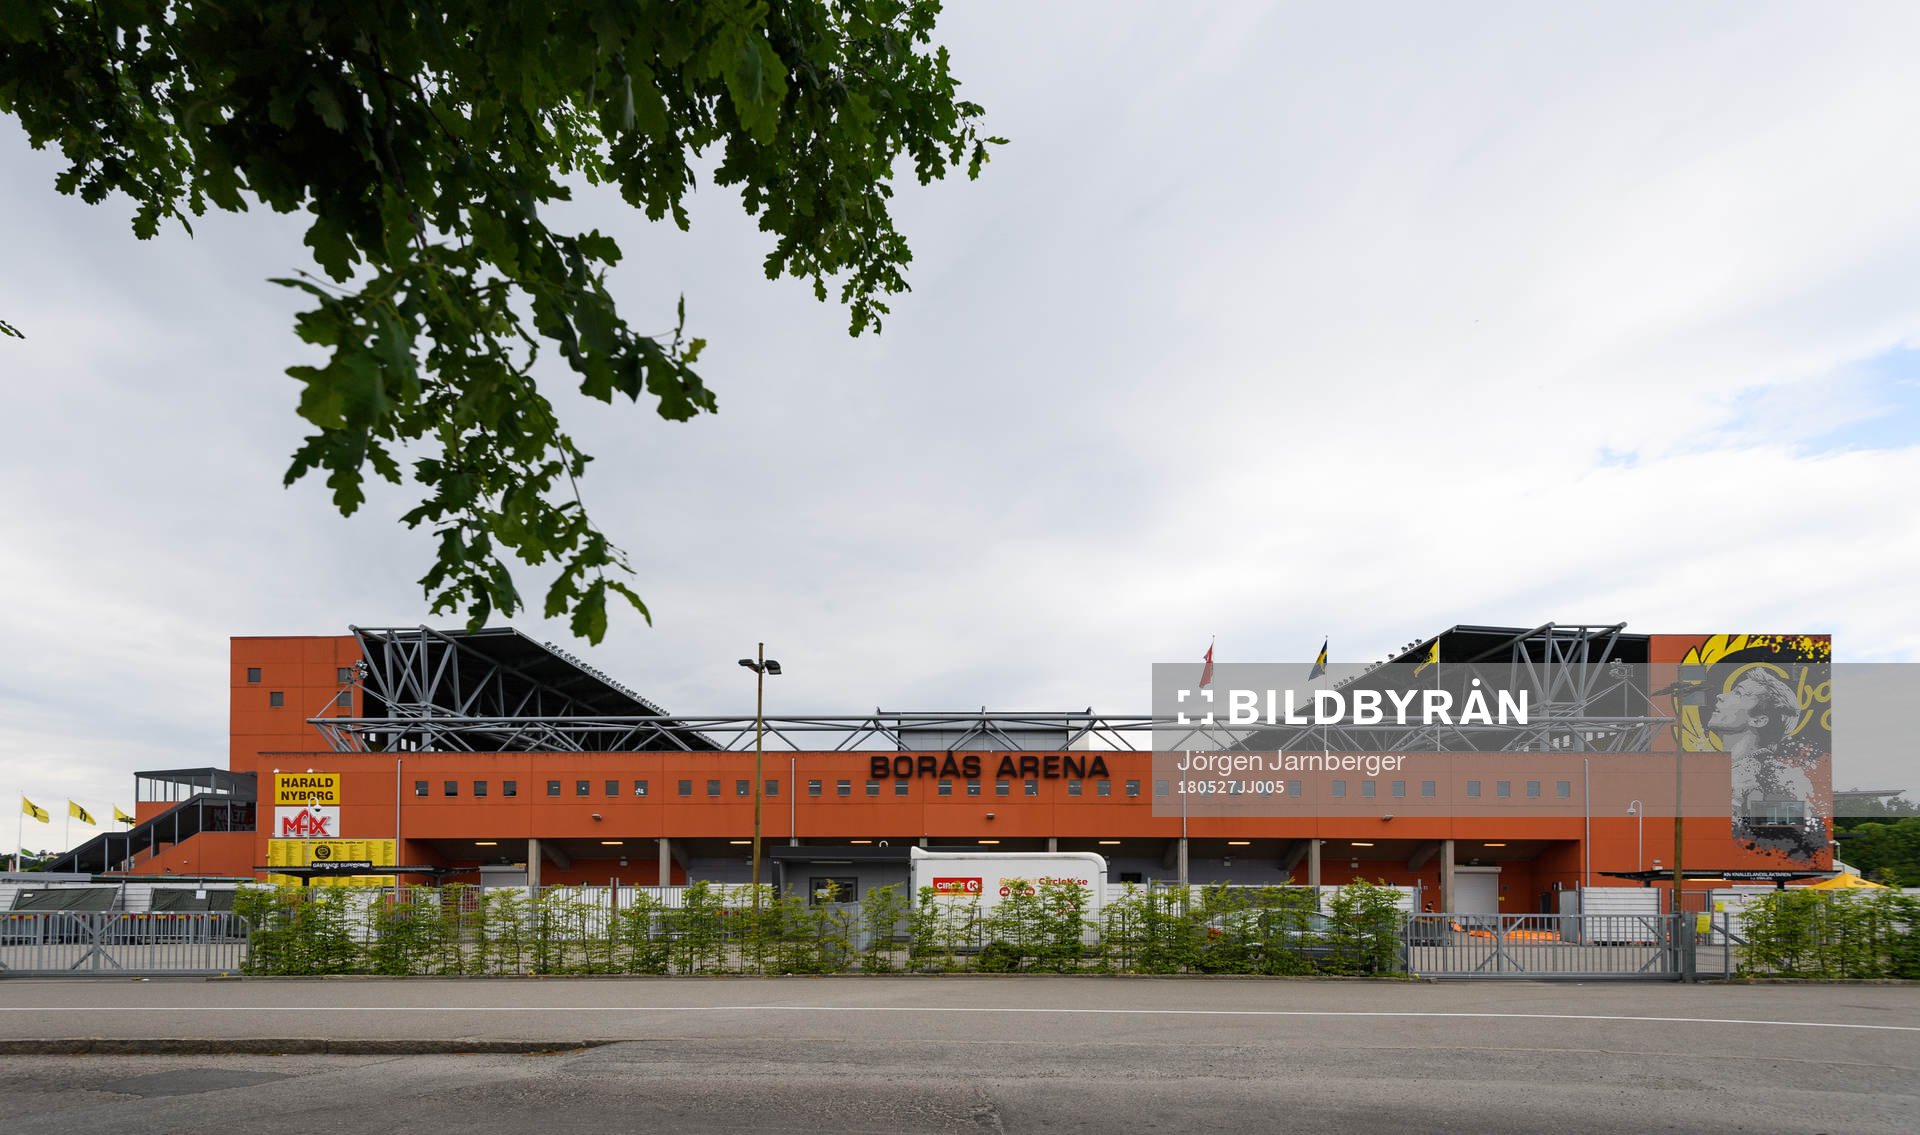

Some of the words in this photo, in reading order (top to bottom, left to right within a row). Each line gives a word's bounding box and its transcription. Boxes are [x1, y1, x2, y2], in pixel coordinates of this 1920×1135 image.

[870, 750, 982, 779] BORÅS
[996, 755, 1110, 779] ARENA
[281, 778, 333, 787] HARALD
[281, 791, 333, 800] NYBORG
[282, 809, 329, 836] MAX
[936, 882, 966, 890] CIRCE
